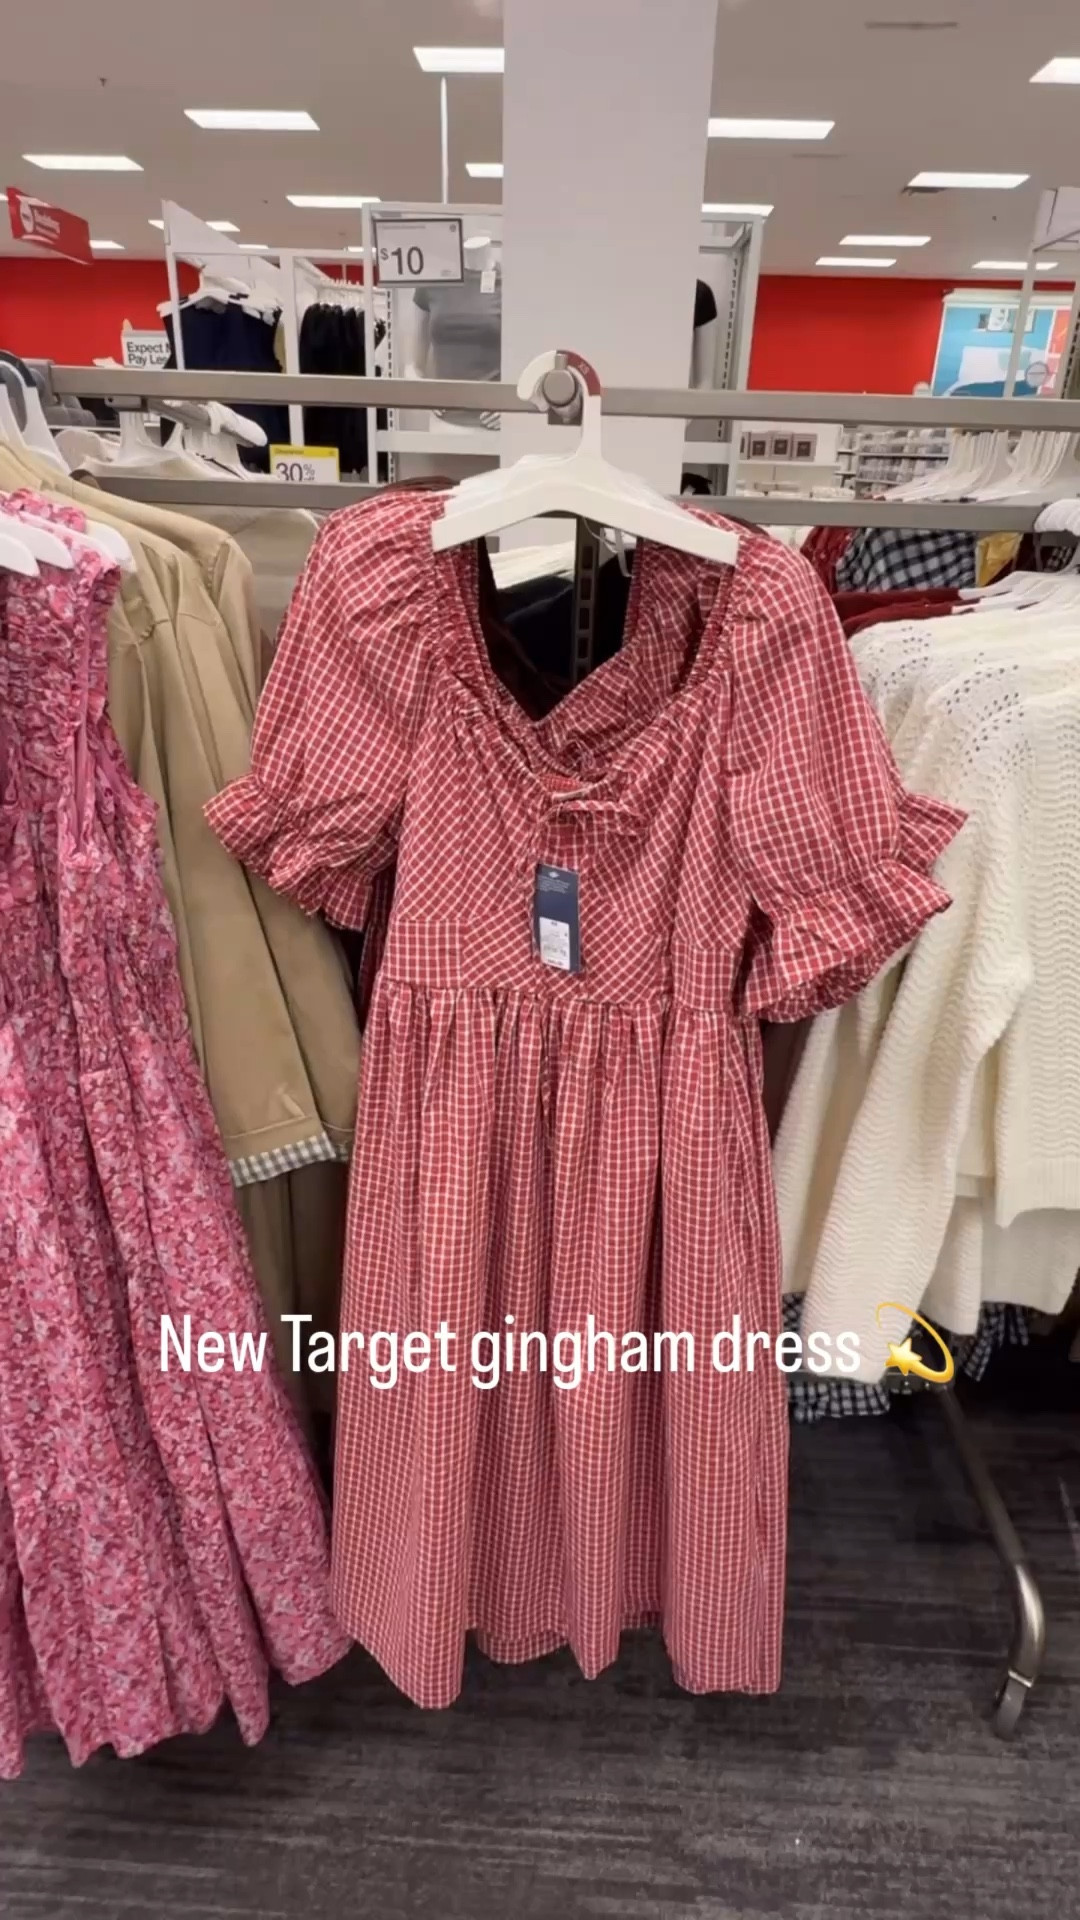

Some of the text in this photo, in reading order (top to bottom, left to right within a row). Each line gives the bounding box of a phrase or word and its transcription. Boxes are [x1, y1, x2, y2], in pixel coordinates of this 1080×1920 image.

[380, 246, 424, 275] $10
[126, 342, 164, 353] Expect
[128, 353, 147, 366] Pay
